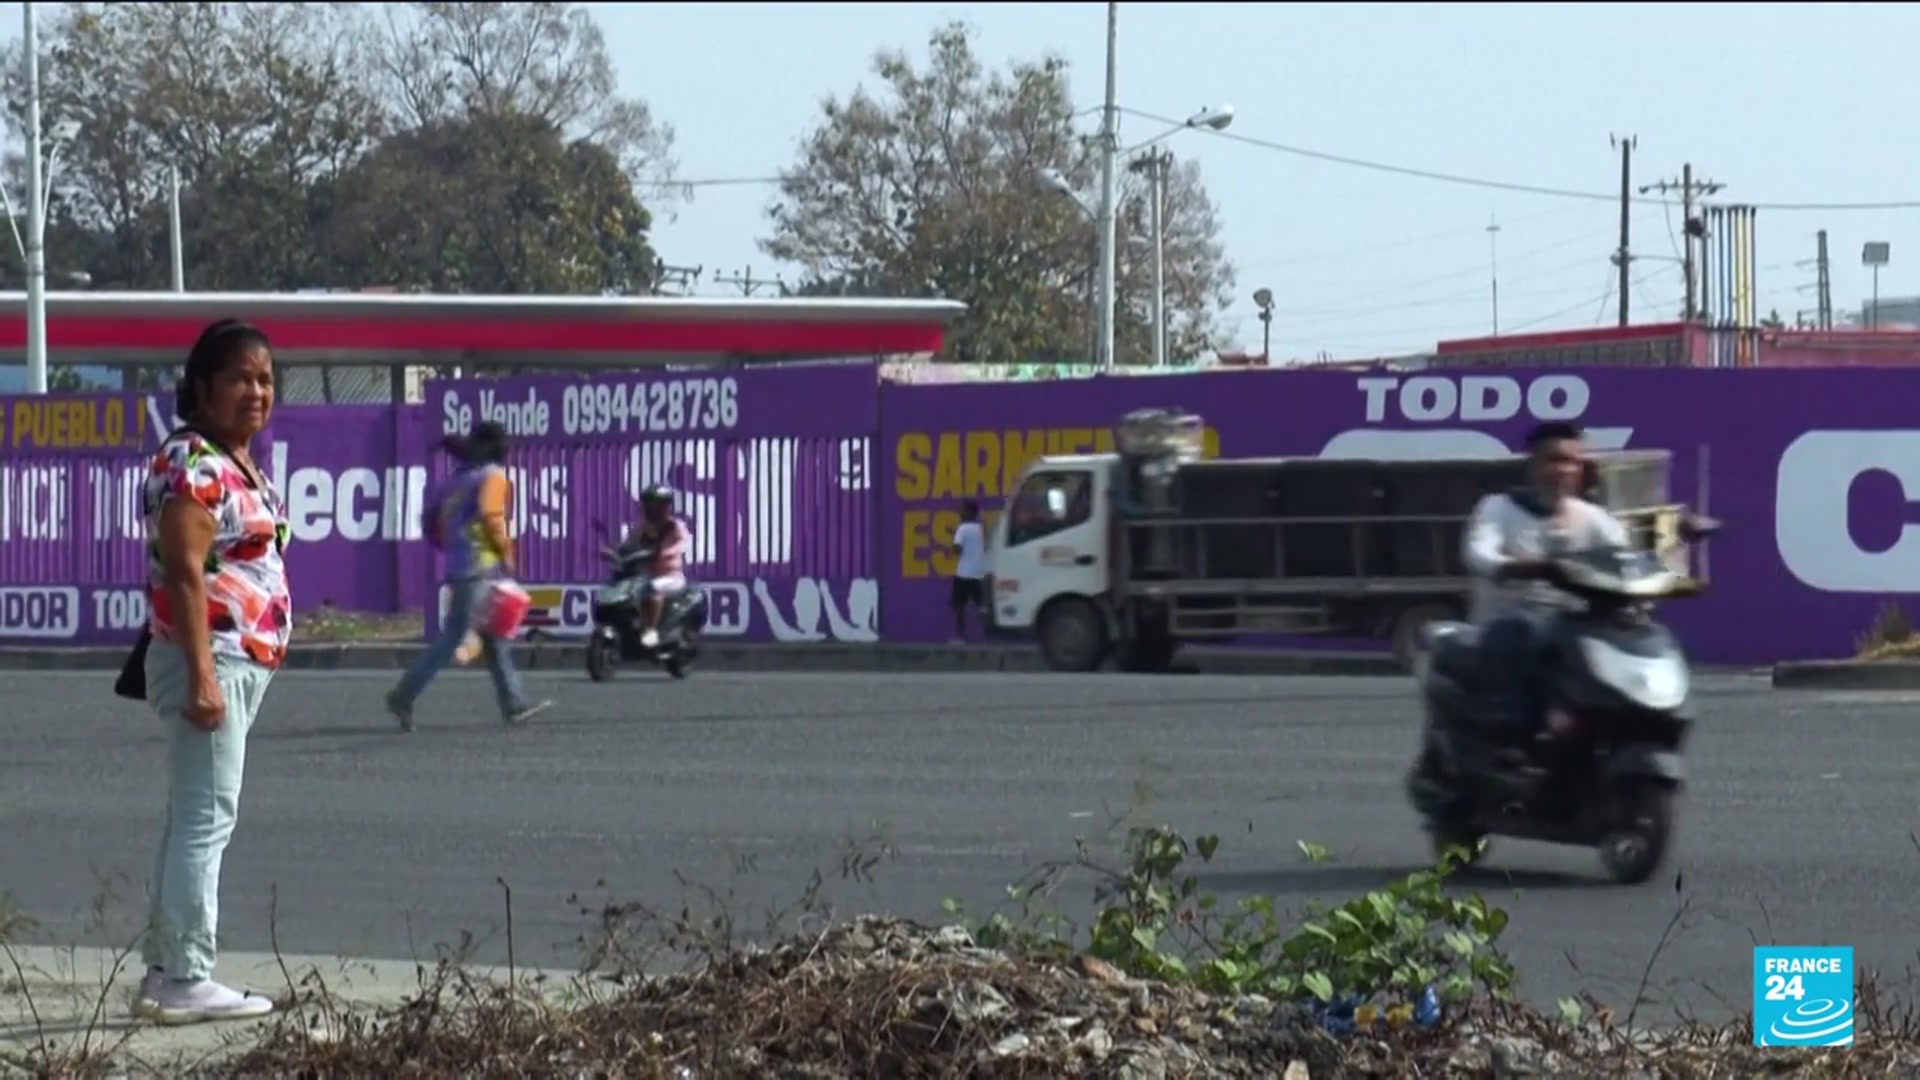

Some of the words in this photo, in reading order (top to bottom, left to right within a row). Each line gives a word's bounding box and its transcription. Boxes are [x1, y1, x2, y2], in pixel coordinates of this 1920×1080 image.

[443, 389, 472, 436] Se
[562, 377, 738, 435] 0994428736
[1357, 374, 1590, 422] TODO
[0, 591, 69, 630] DOR
[92, 589, 148, 630] TOD
